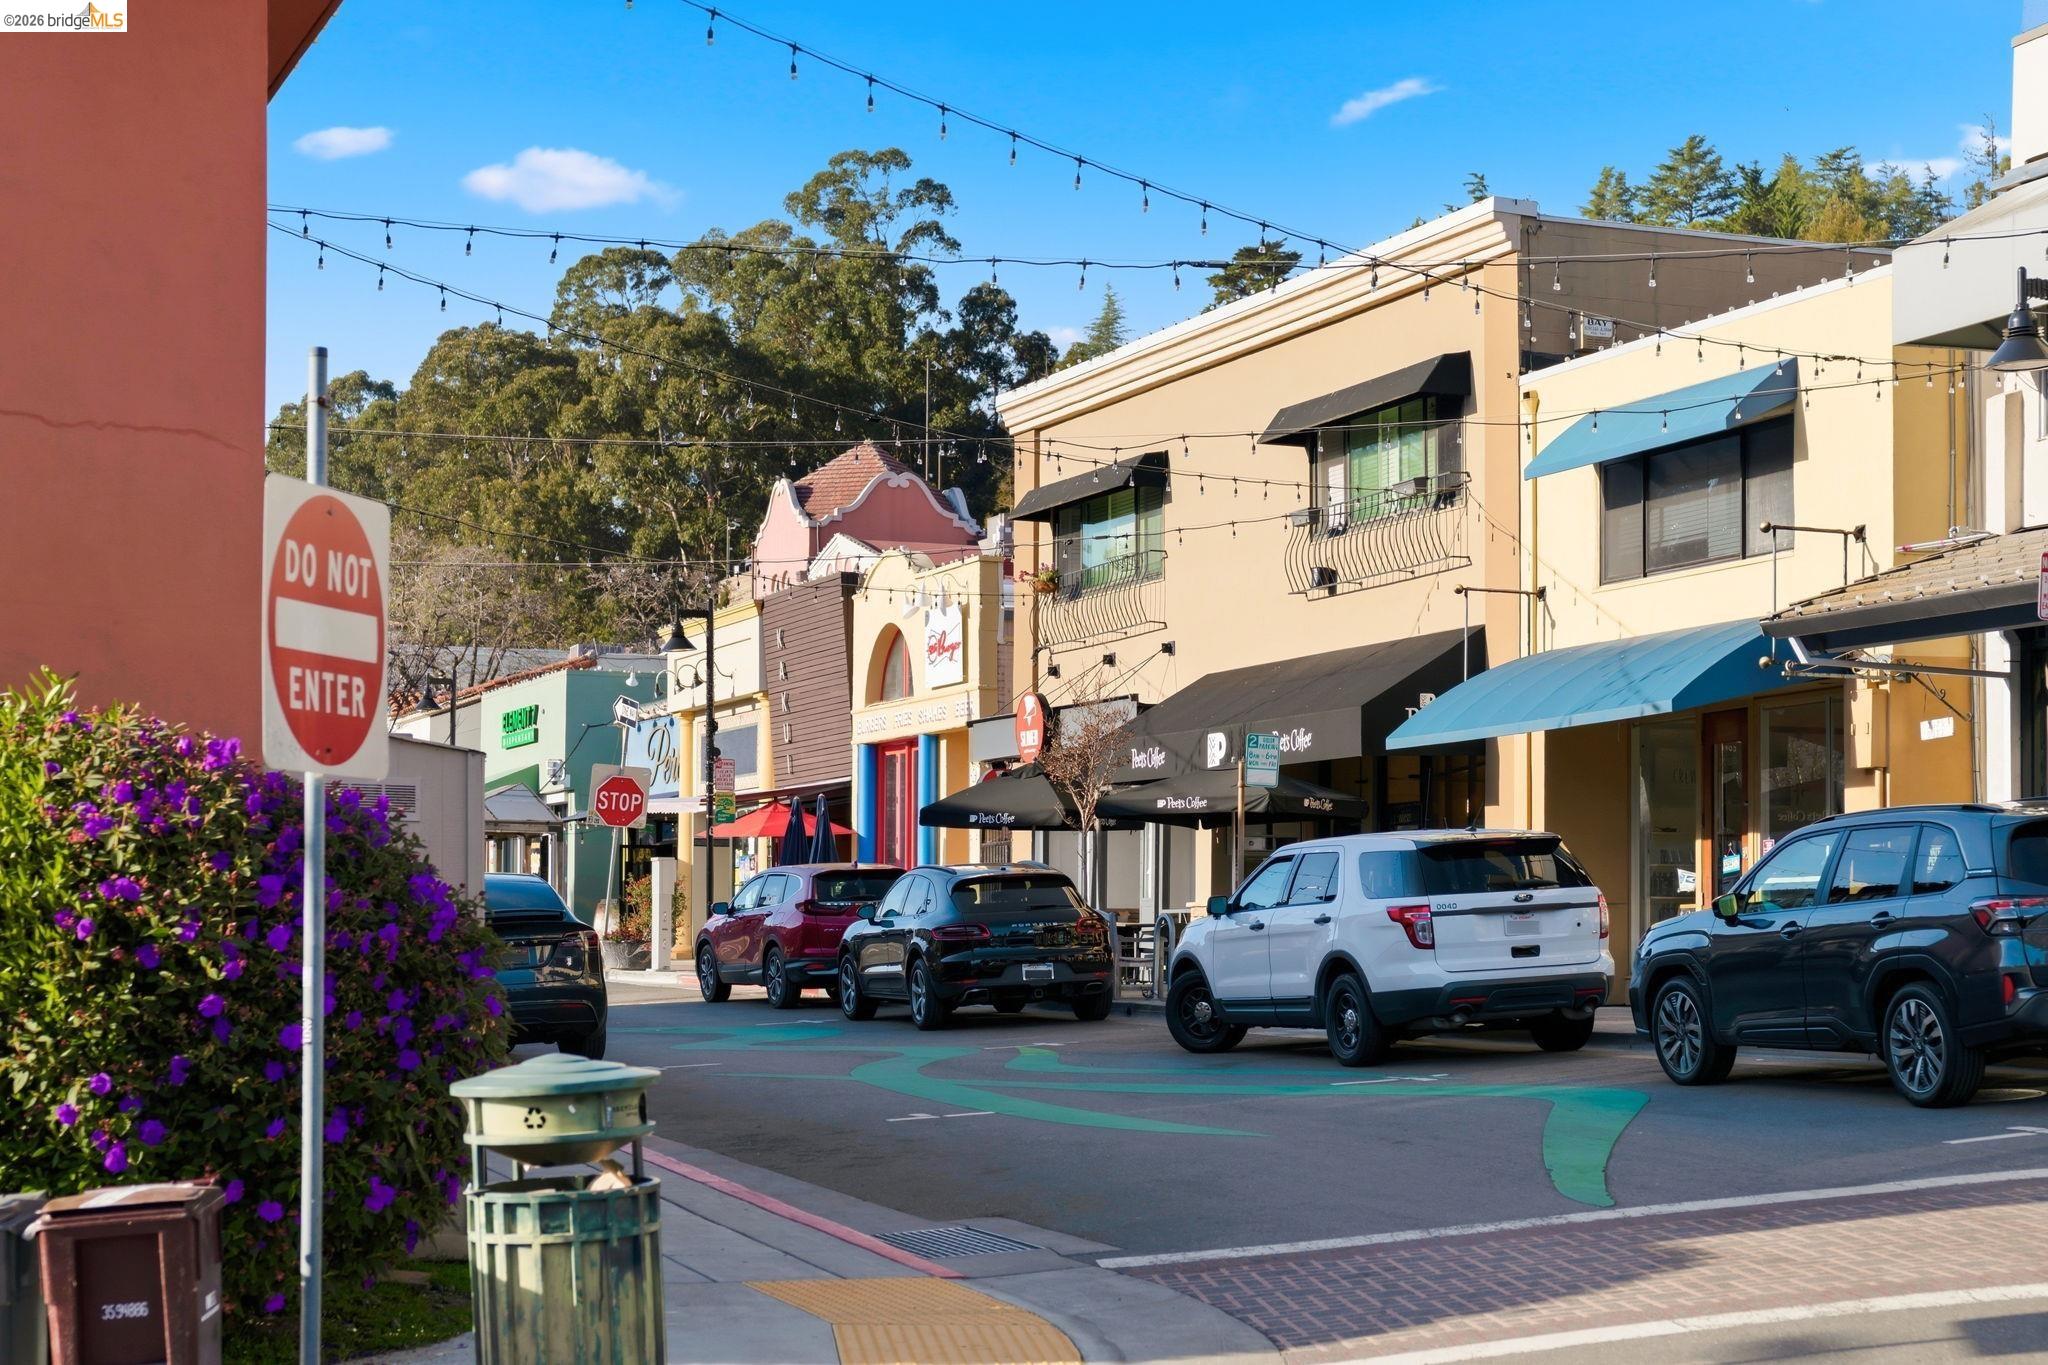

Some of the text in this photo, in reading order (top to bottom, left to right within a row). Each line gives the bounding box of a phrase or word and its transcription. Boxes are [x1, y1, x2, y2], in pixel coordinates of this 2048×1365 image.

[285, 538, 372, 599] DO NOT
[289, 666, 366, 719] ENTER
[776, 627, 795, 775] KAKUI
[955, 699, 976, 719] BEER
[1249, 735, 1258, 747] 2
[1291, 727, 1312, 752] Coffee
[1147, 746, 1166, 769] Coffee
[598, 790, 642, 812] STOP
[1186, 796, 1207, 809] Coffee
[995, 812, 1015, 824] Coffee
[1436, 902, 1458, 910] 0040
